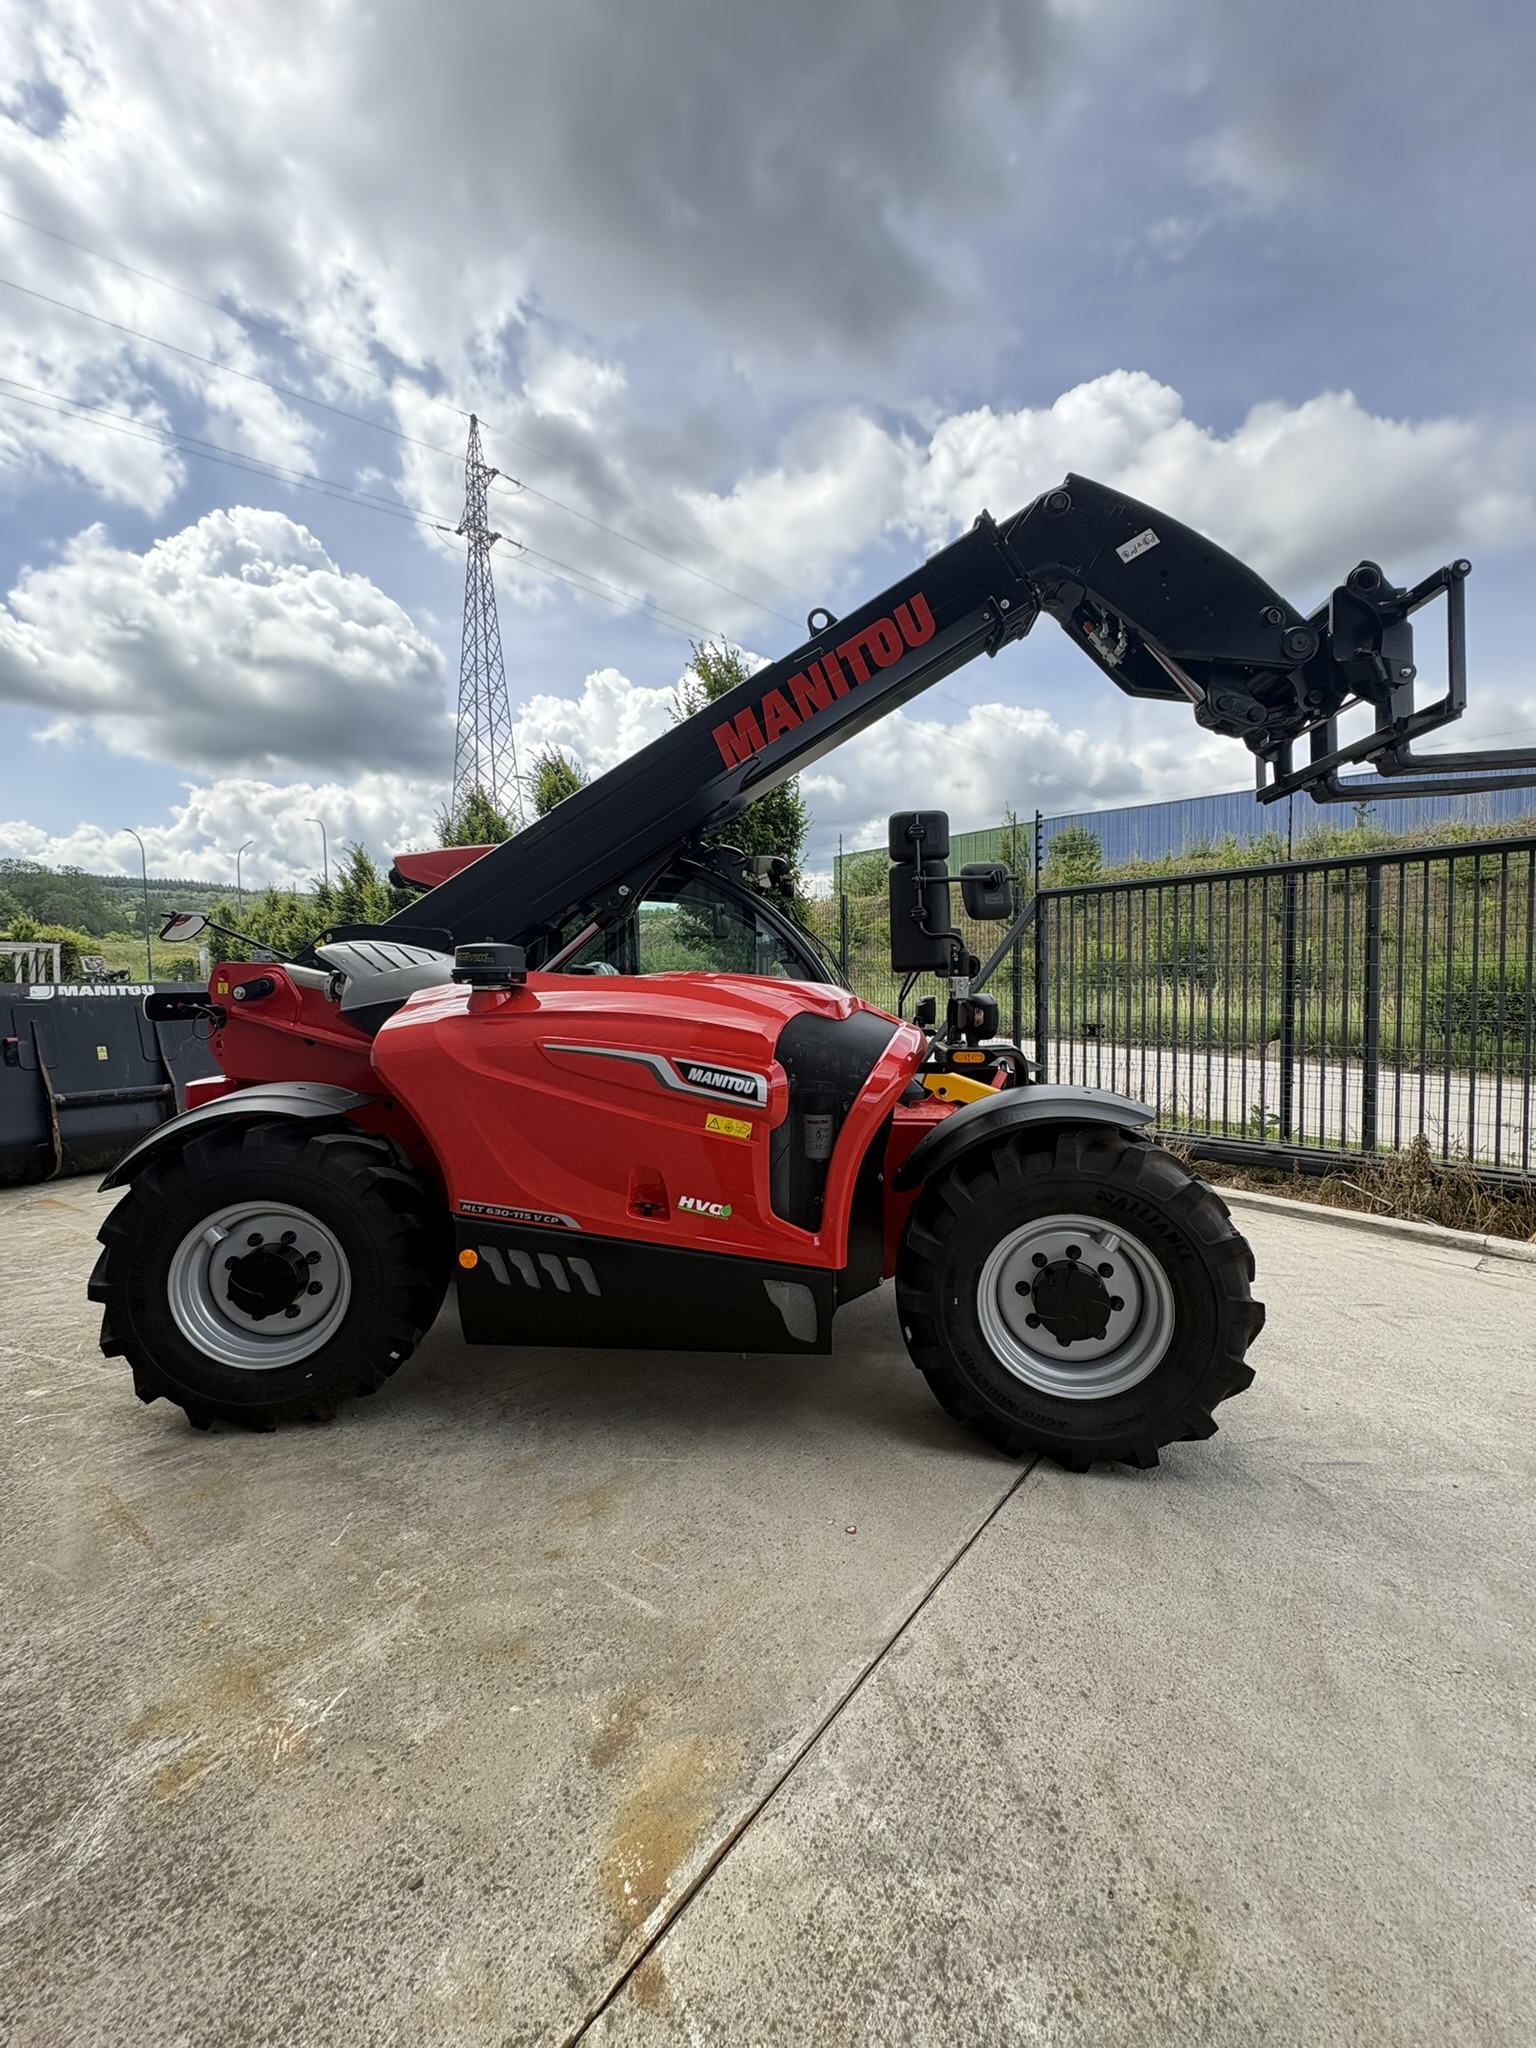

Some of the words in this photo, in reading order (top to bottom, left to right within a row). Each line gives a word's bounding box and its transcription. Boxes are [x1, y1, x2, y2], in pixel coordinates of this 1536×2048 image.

[711, 591, 936, 771] MANITOU
[57, 984, 155, 997] MANITOU
[687, 1067, 756, 1094] MANITOU
[462, 1204, 484, 1213] MLT
[486, 1208, 531, 1220] 630-115
[1108, 1196, 1195, 1263] ALLIANCE
